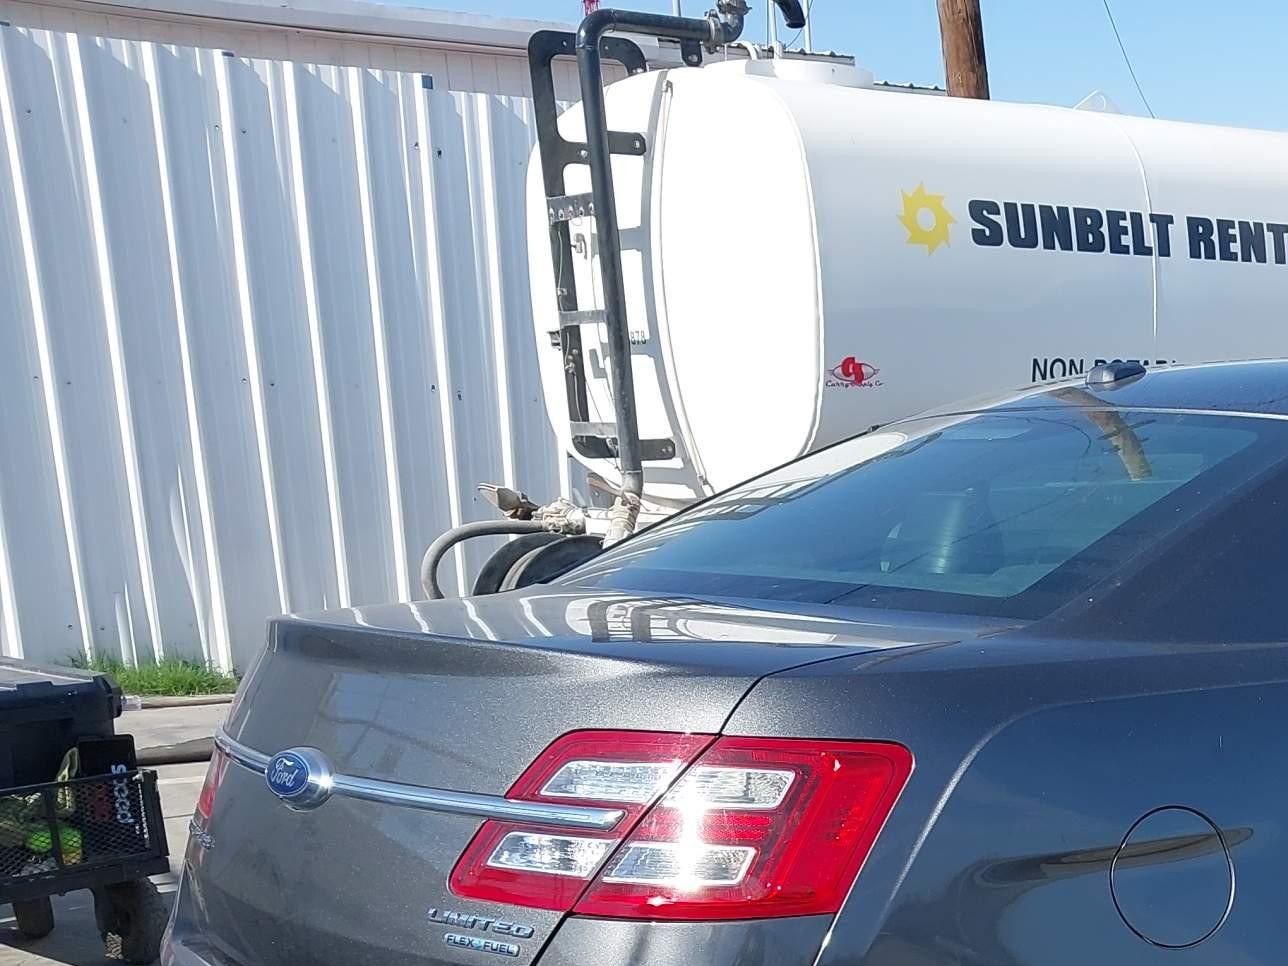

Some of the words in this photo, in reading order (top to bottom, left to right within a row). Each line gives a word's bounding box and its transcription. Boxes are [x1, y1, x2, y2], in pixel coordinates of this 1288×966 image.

[968, 199, 1174, 258] SUNBELT
[427, 908, 535, 939] LIMITED
[447, 935, 474, 948] FLEX
[483, 941, 514, 955] FUEL
